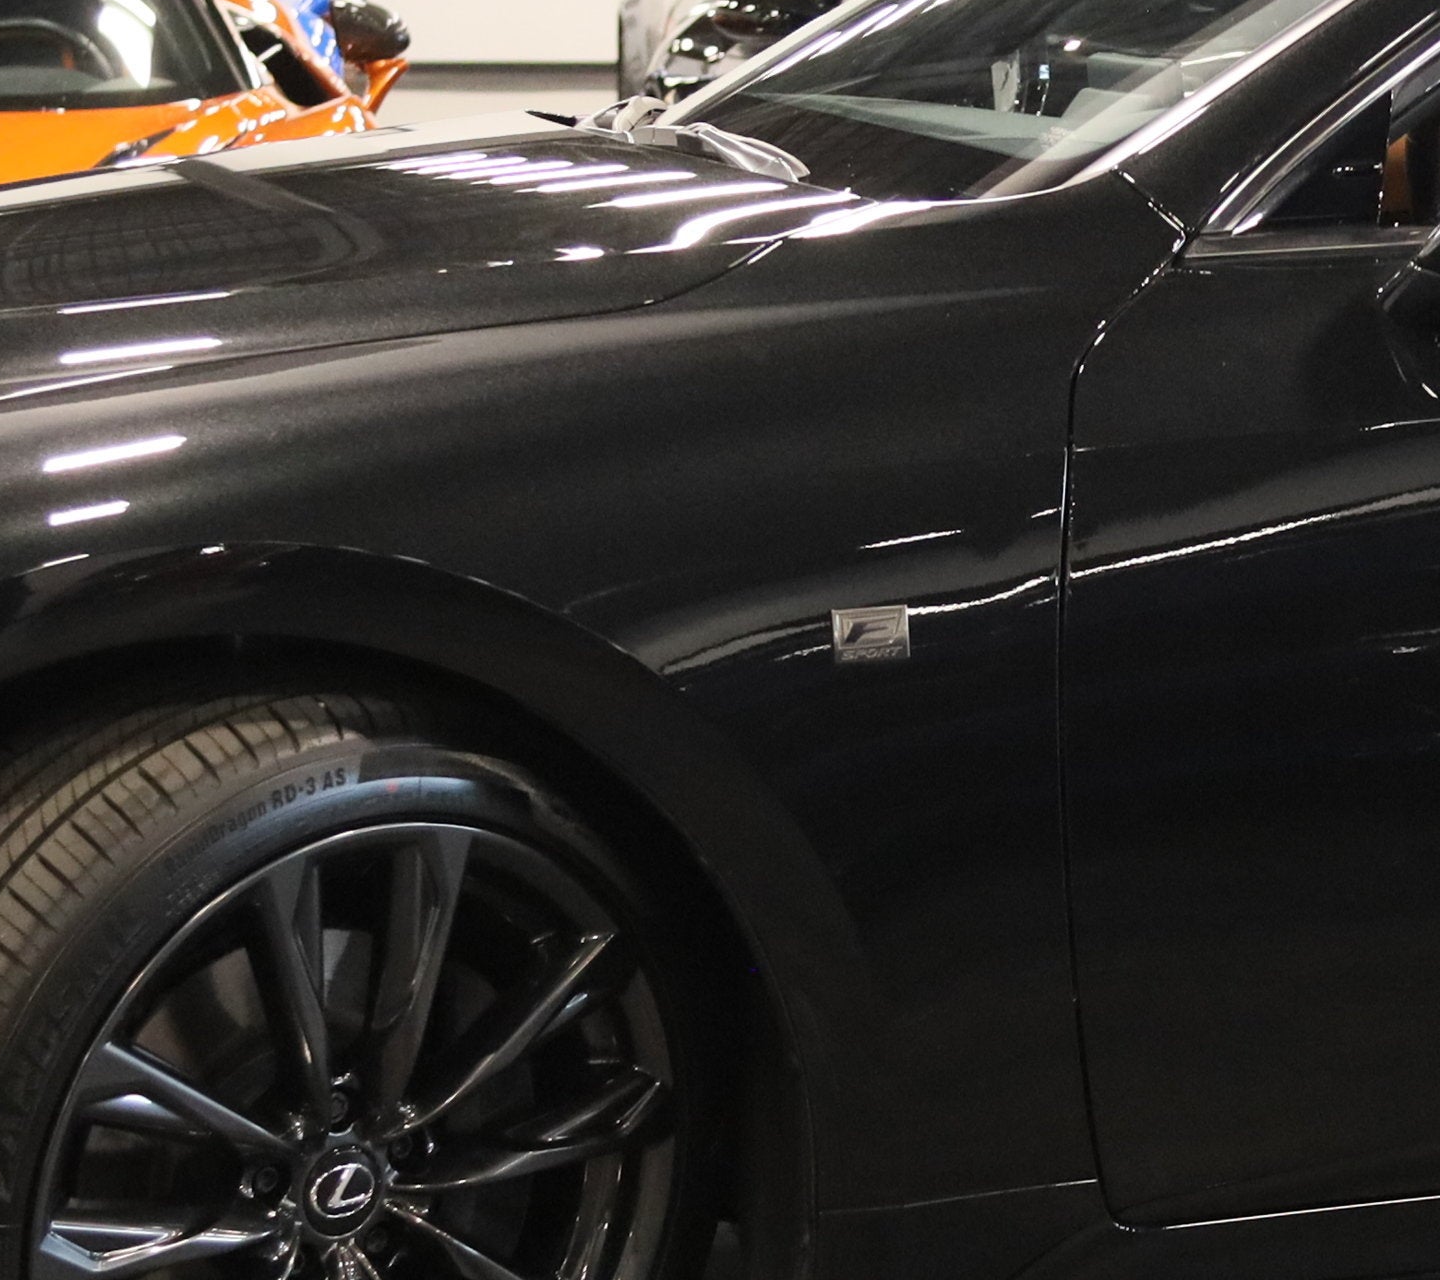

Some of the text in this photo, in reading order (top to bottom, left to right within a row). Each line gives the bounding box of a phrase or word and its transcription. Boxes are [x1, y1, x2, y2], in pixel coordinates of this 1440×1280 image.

[841, 646, 903, 661] SPORT
[270, 776, 316, 810] RD-3
[322, 767, 347, 791] AS
